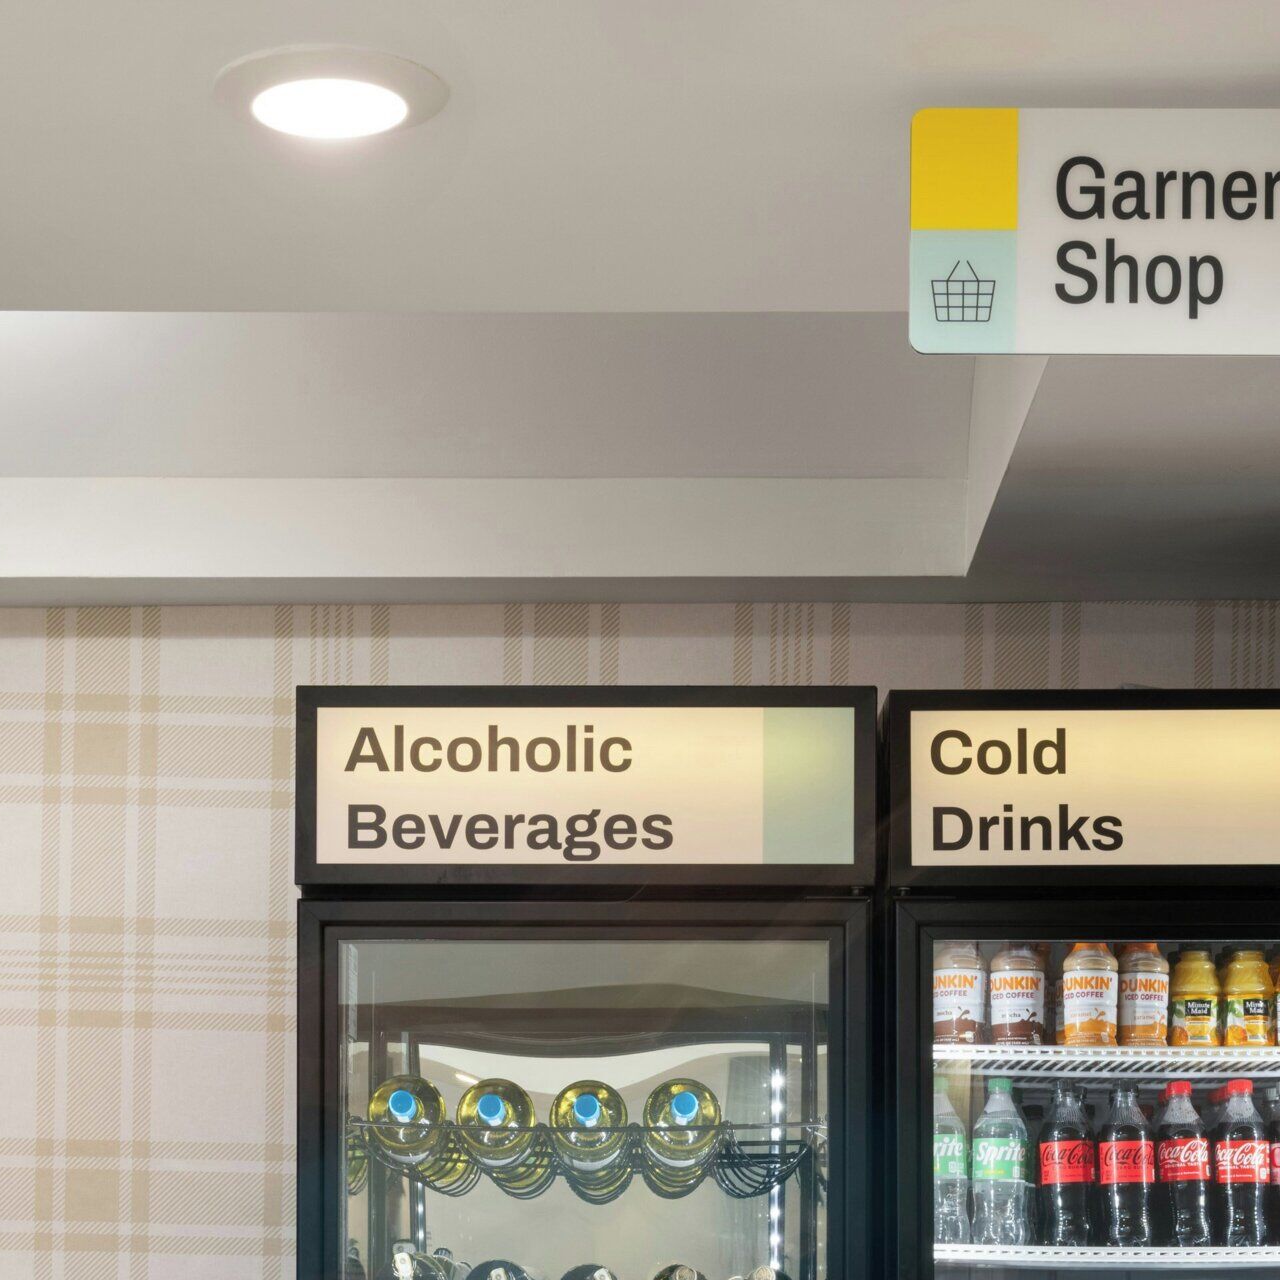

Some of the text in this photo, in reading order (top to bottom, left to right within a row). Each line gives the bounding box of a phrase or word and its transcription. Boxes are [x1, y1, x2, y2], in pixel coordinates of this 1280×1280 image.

[1054, 238, 1224, 319] Shop
[344, 724, 633, 773] Alcoholic
[930, 728, 1066, 775] Cold
[347, 803, 674, 861] Beverages
[932, 804, 1124, 851] Drinks
[933, 975, 978, 989] UNKIN'
[934, 1136, 963, 1157] rite
[976, 1142, 1026, 1165] Sprite
[1216, 1142, 1265, 1166] oca-Cola
